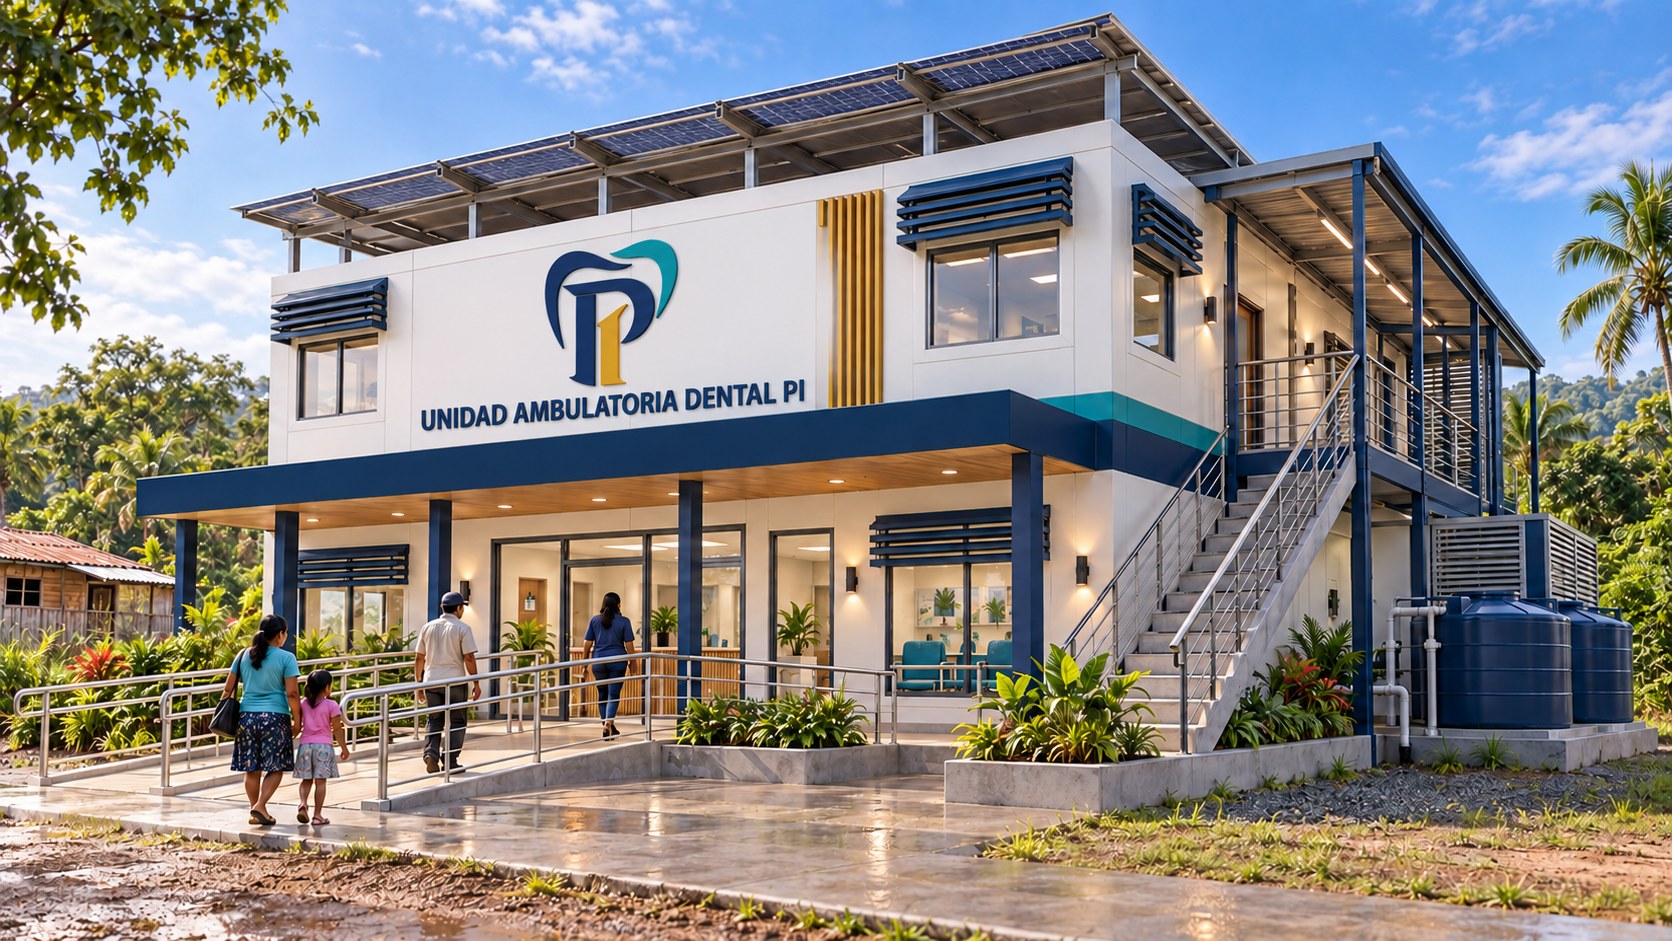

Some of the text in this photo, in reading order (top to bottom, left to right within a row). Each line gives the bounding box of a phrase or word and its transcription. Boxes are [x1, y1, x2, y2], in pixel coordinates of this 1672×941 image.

[421, 379, 805, 431] UNIDAD AMBULATORIA DENTAL PI
